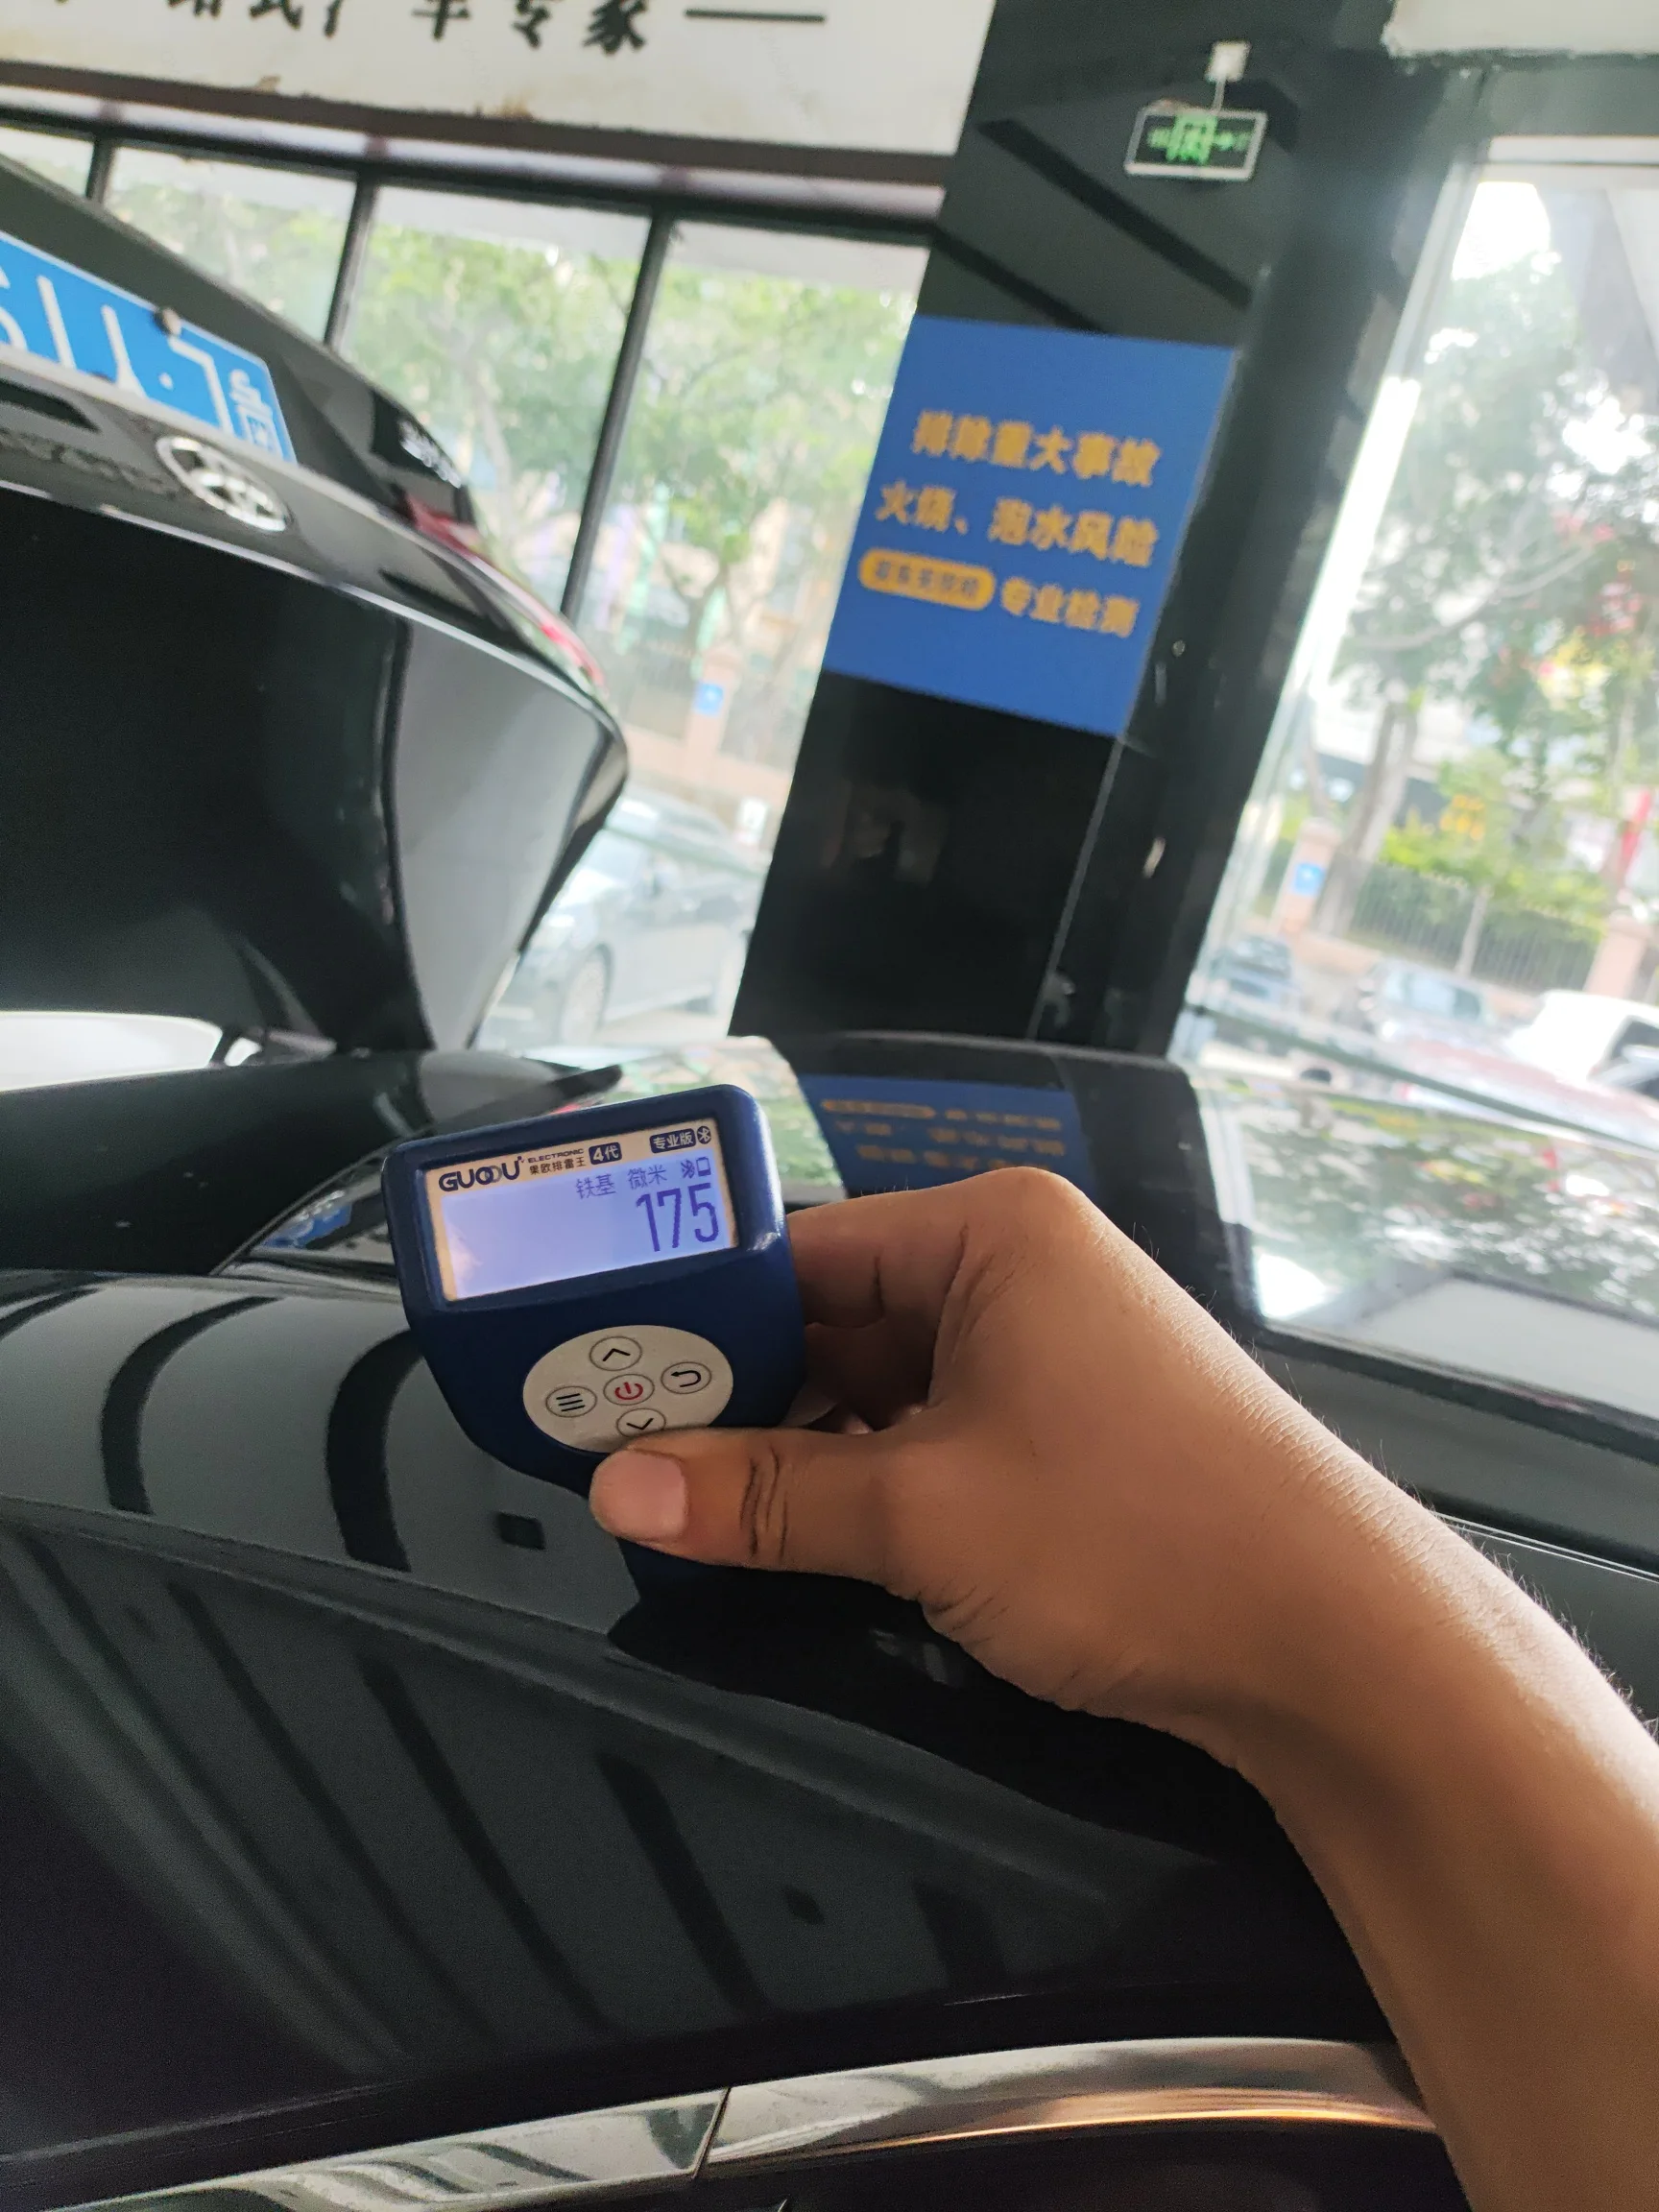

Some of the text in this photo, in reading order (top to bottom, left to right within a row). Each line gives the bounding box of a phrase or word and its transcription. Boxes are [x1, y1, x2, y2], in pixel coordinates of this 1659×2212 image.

[653, 1133, 693, 1150] 专业版
[527, 1148, 584, 1164] ELECTRONIC
[592, 1144, 619, 1162] 4代
[576, 1165, 668, 1200] 铁基 微米
[636, 1182, 720, 1252] 175
